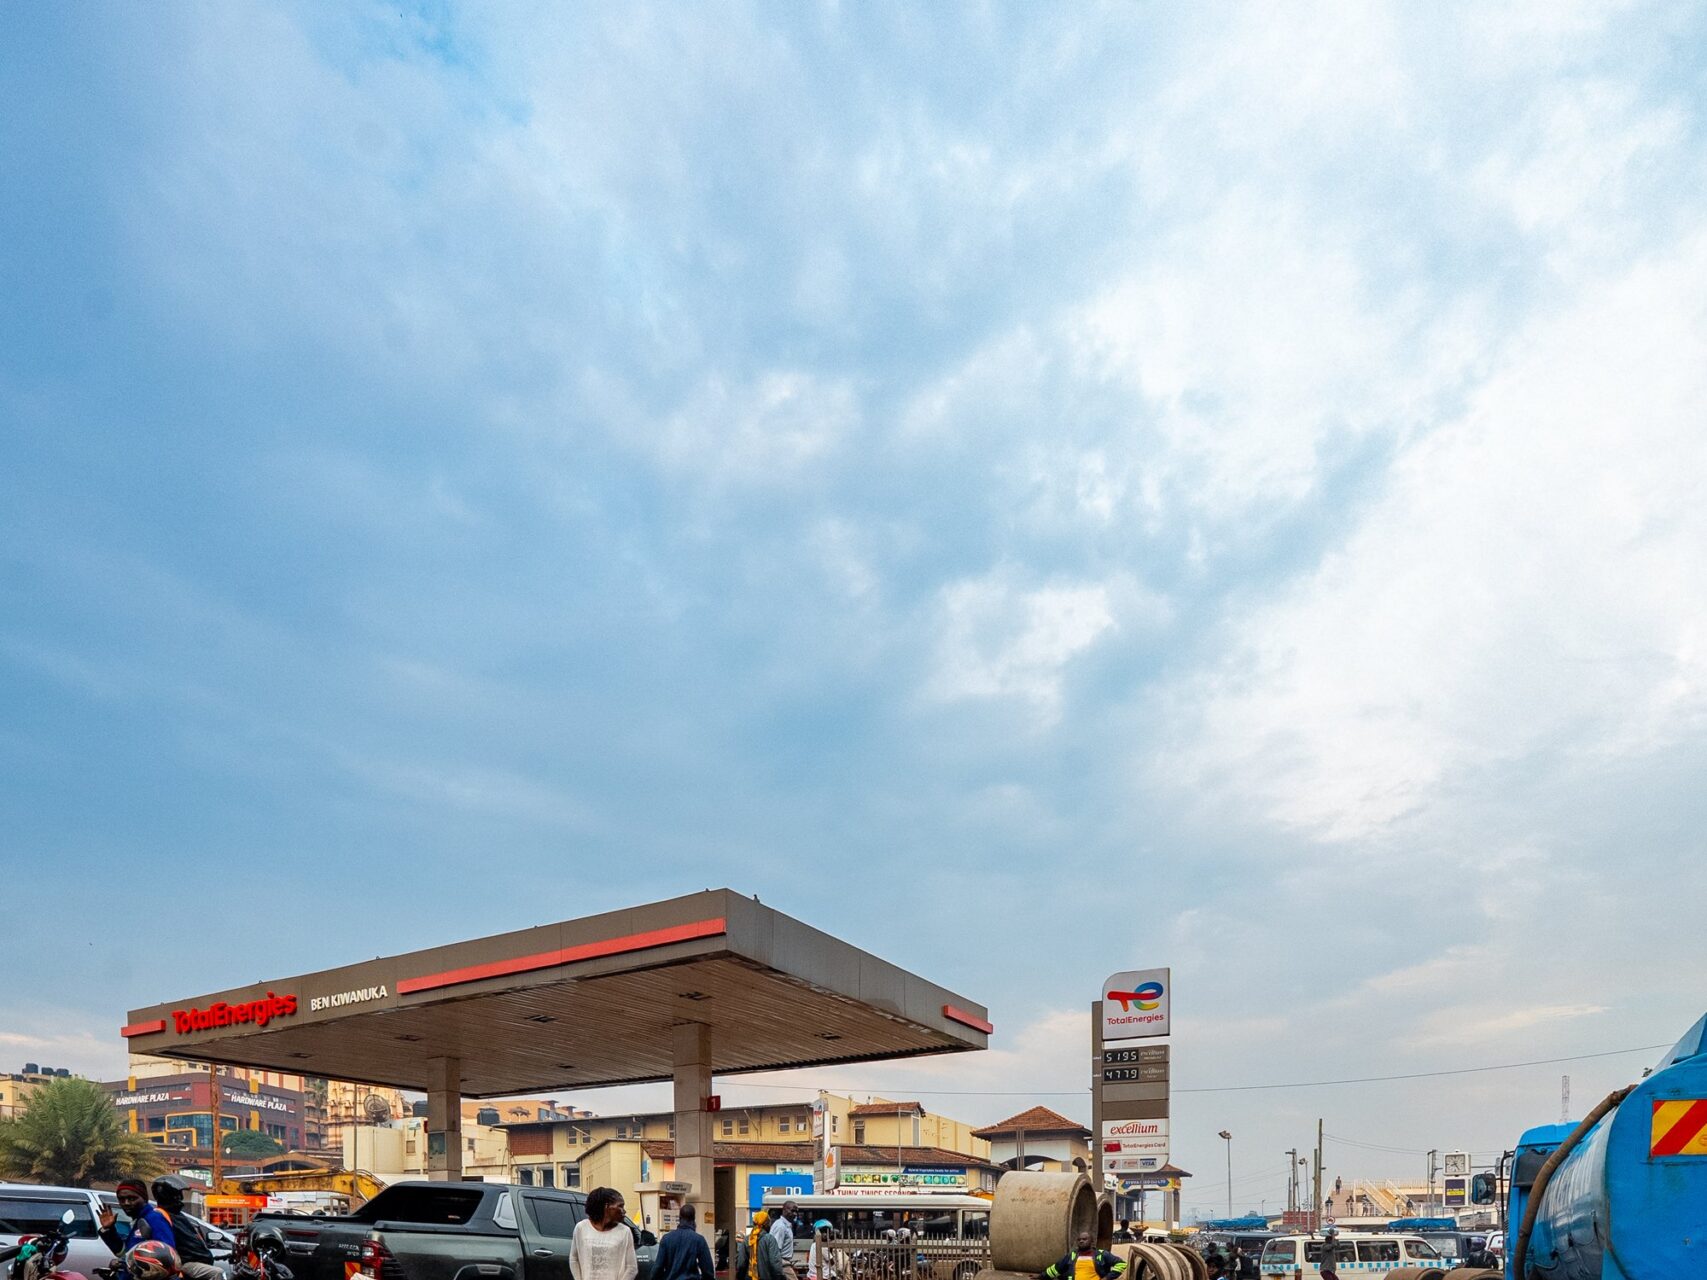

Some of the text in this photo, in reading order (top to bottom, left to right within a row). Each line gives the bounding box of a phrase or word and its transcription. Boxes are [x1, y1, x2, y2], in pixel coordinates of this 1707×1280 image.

[310, 985, 388, 1011] BEN KIWANUKA
[172, 991, 297, 1034] TotalEnergies
[1107, 1013, 1164, 1025] TotalEnergies
[1105, 1051, 1137, 1062] 5195
[1105, 1069, 1137, 1079] 4779
[116, 1092, 170, 1105] HARDWARE PLAZA
[231, 1094, 287, 1112] HARDWARE PLAZA
[711, 1097, 716, 1109] 1
[1110, 1121, 1158, 1134] excellium
